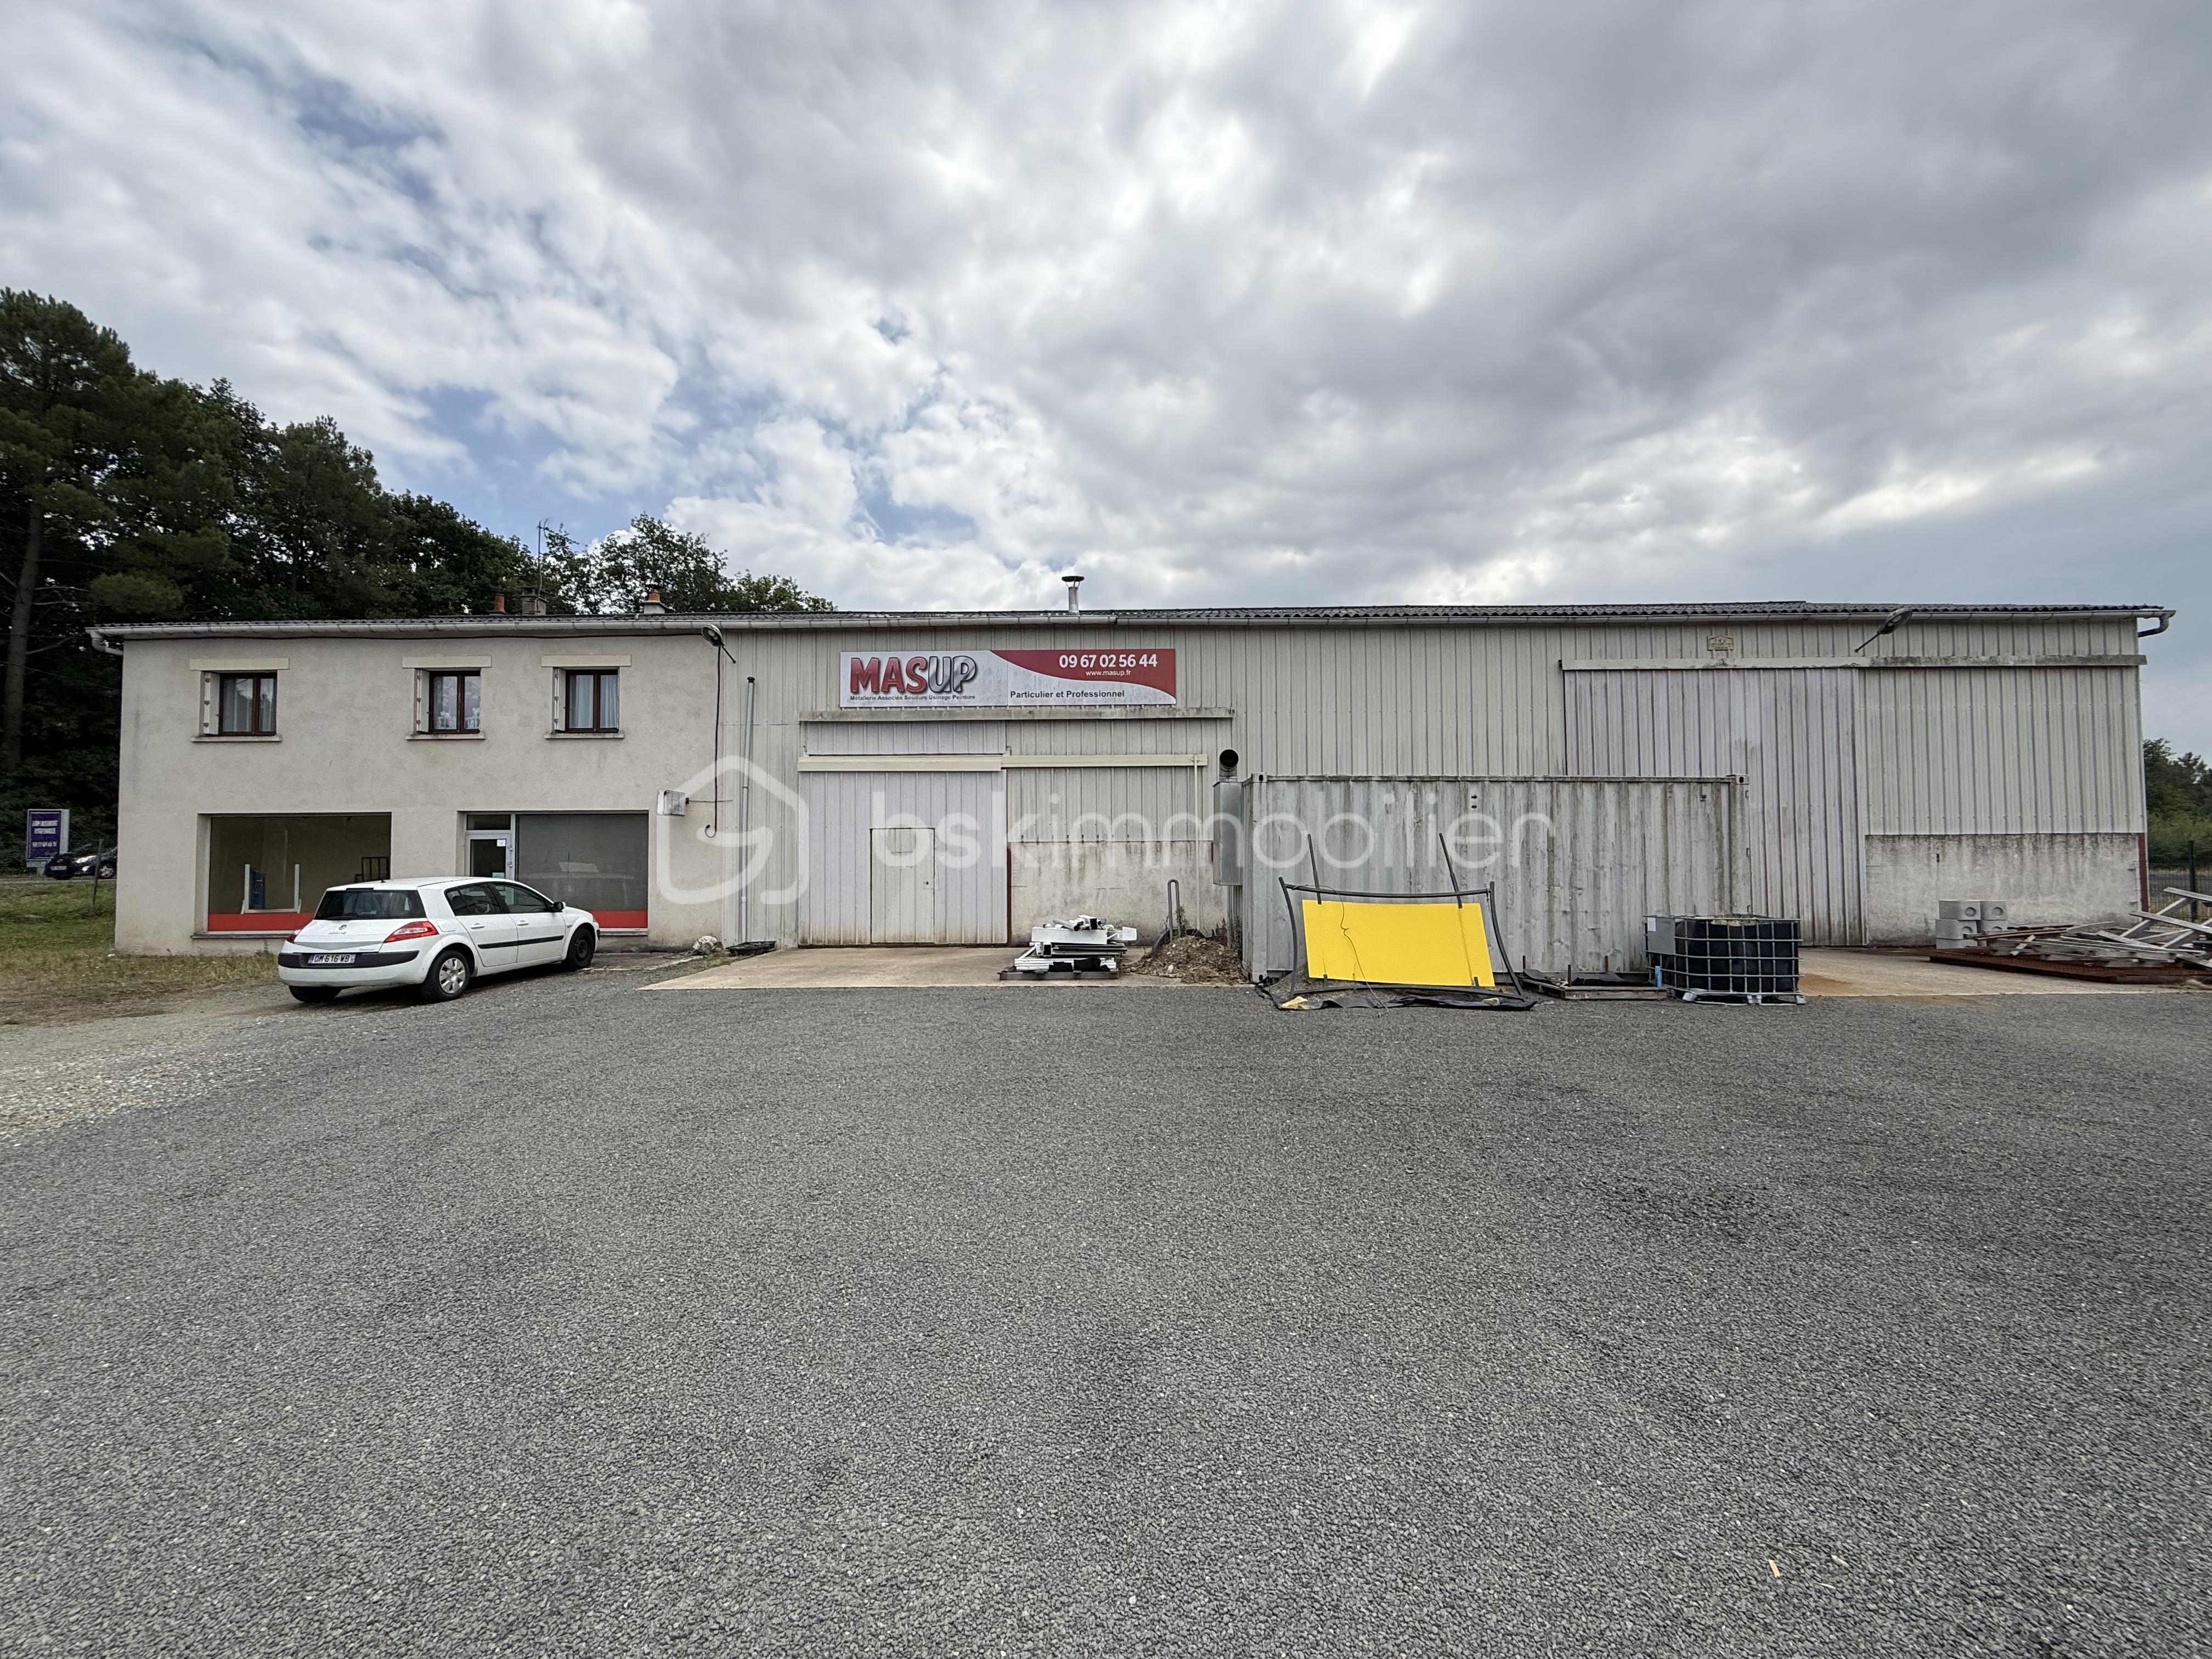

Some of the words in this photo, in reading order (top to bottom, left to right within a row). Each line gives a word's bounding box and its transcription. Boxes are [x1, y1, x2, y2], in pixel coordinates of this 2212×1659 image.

[1059, 654, 1078, 668] 09
[1080, 654, 1097, 668] 67
[1099, 654, 1116, 668] 02
[1119, 654, 1136, 668] 56
[1138, 653, 1158, 667] 44
[850, 655, 977, 693] MASUP
[1066, 690, 1125, 698] Professionnel
